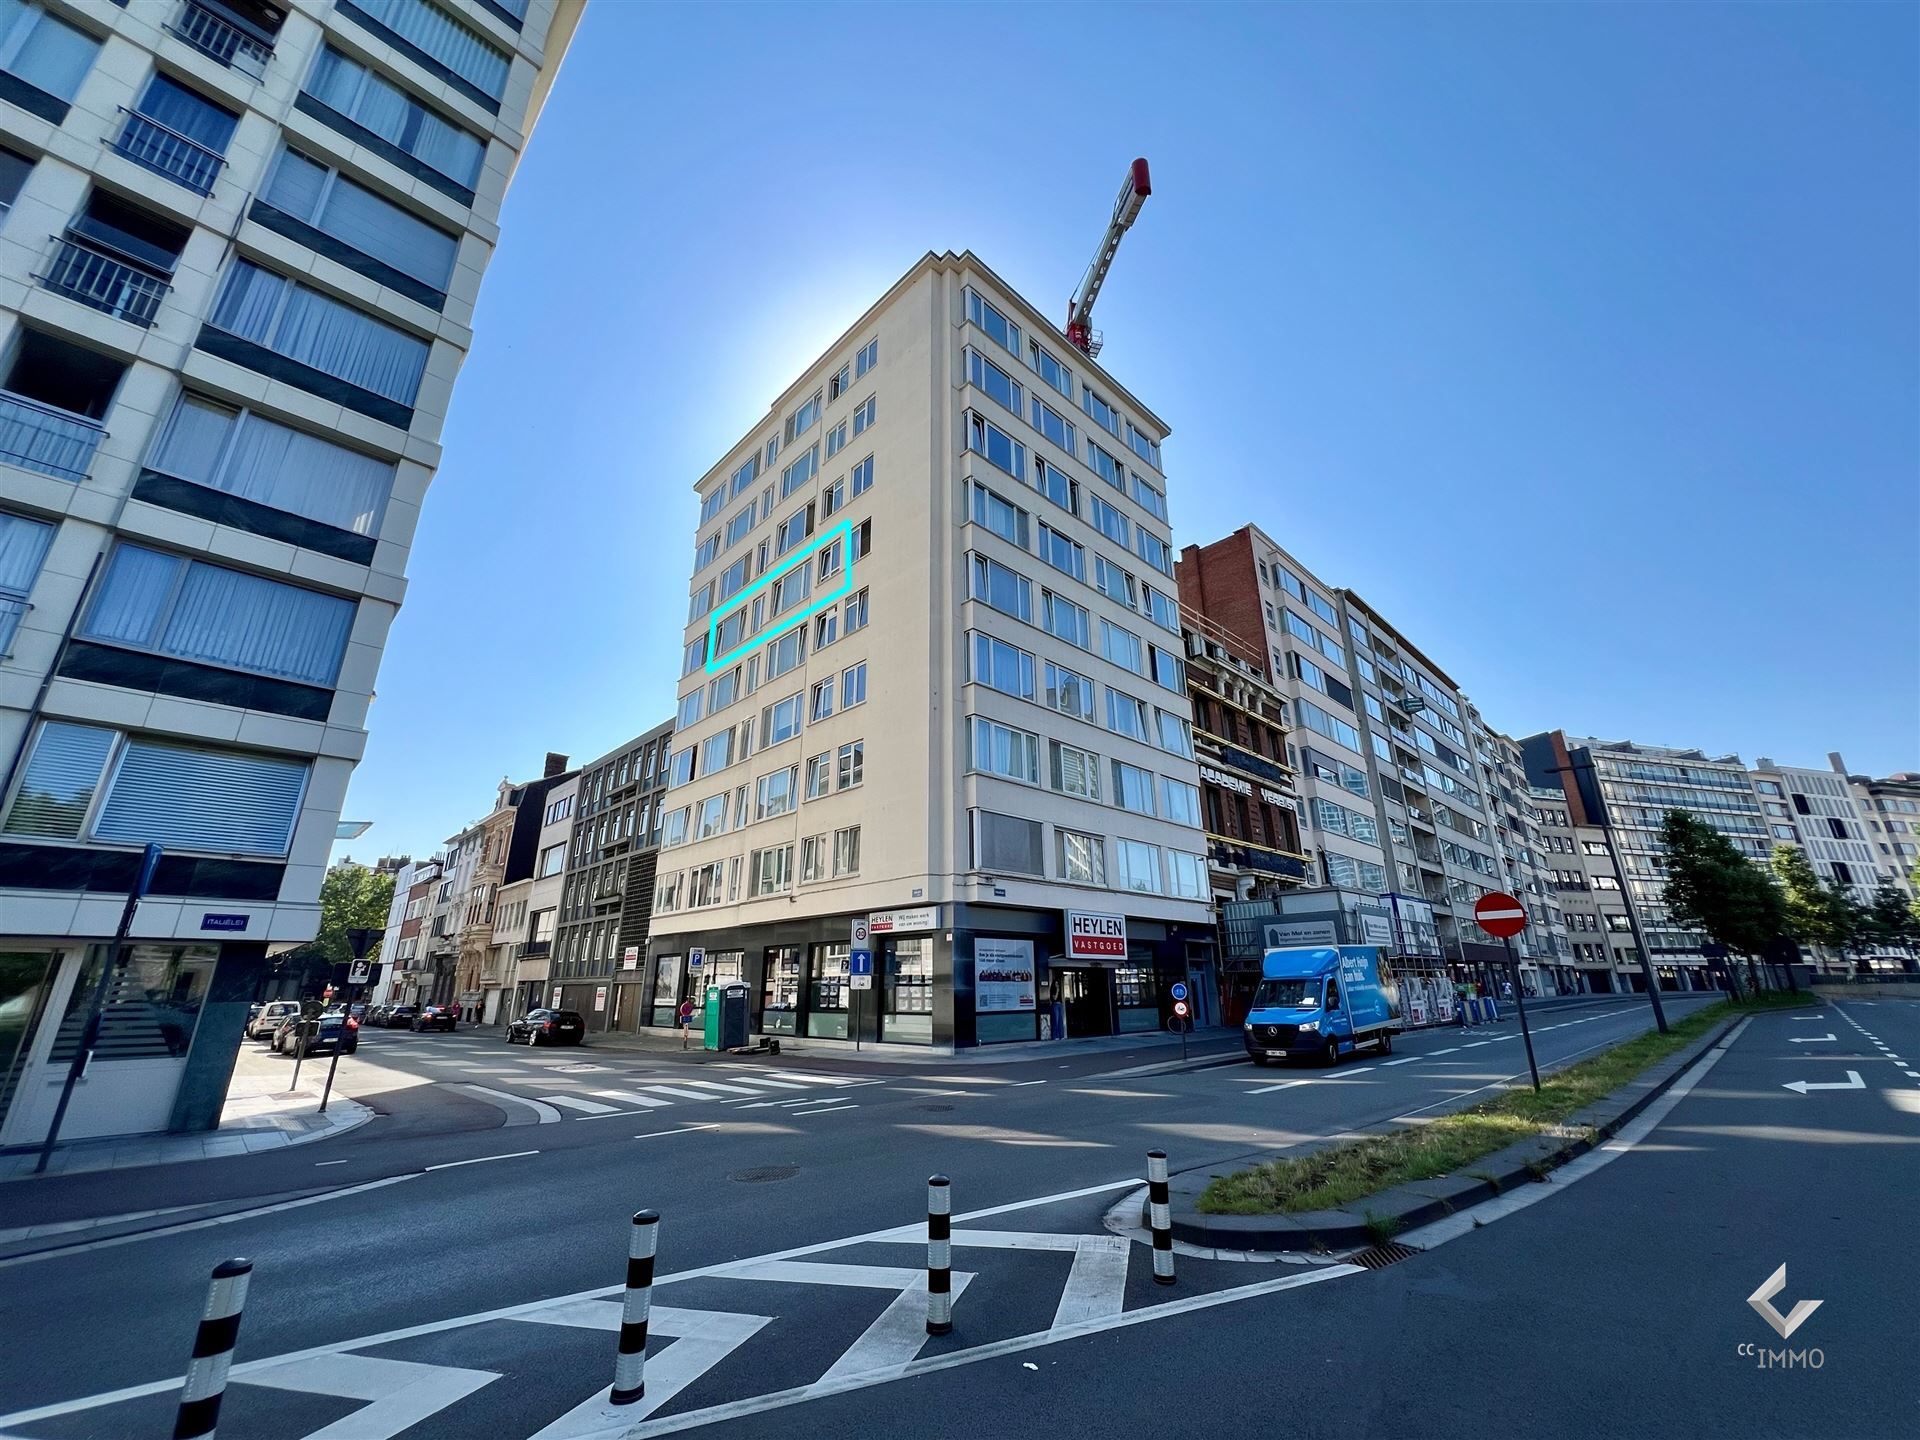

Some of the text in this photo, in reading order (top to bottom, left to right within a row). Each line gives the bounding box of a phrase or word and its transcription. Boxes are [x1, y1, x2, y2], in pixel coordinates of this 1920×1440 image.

[871, 915, 893, 924] HEYLEN
[1073, 917, 1122, 935] HEYLEN
[1074, 940, 1123, 951] VASTGOED
[694, 954, 700, 963] P
[1342, 956, 1357, 969] Albert
